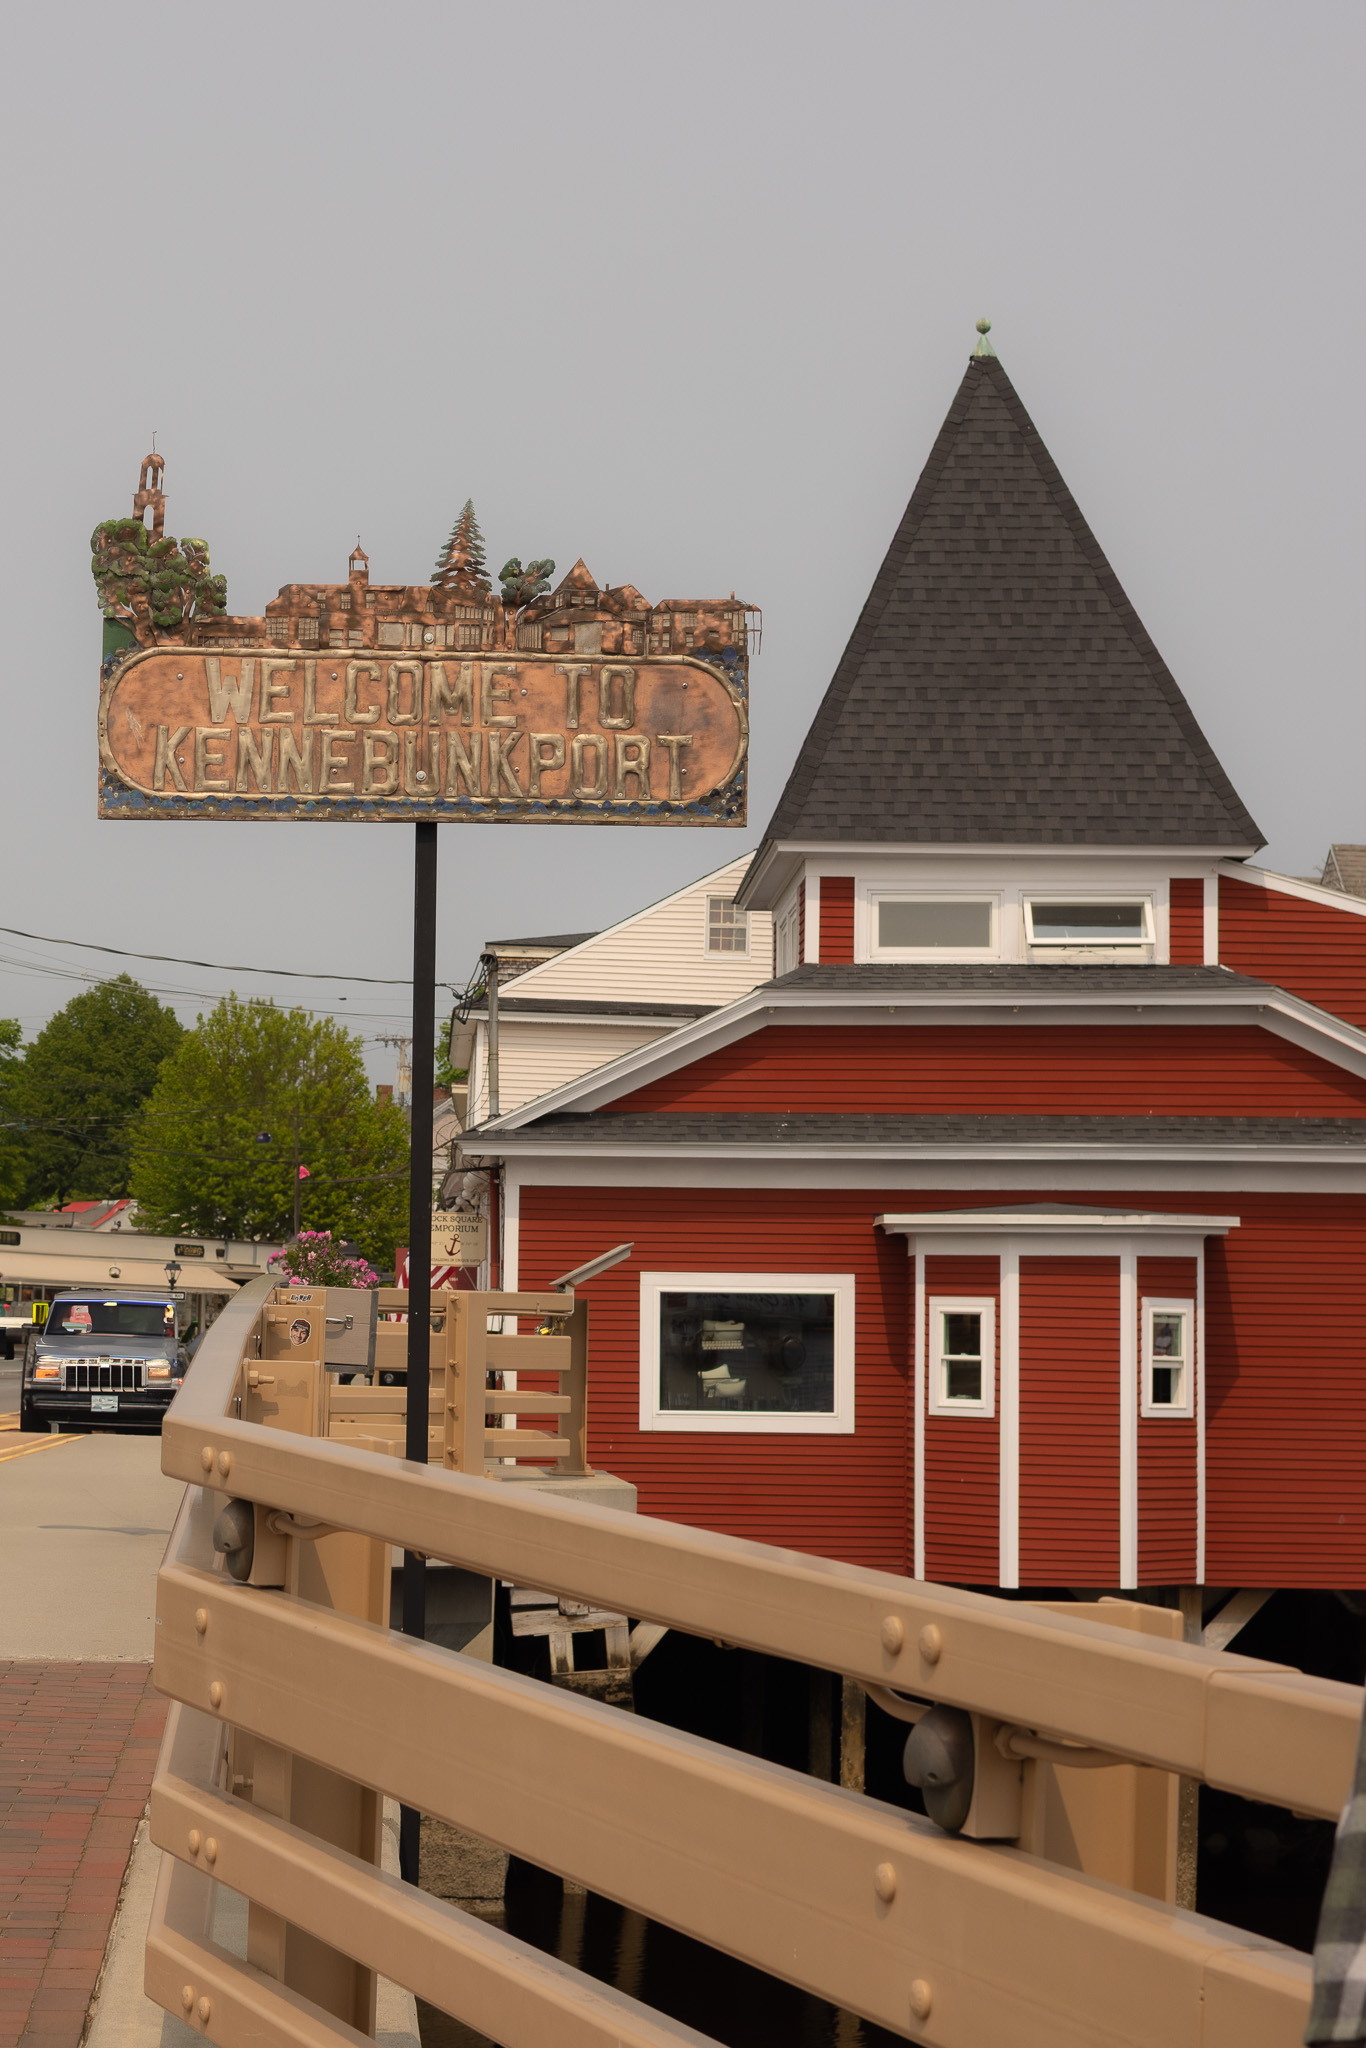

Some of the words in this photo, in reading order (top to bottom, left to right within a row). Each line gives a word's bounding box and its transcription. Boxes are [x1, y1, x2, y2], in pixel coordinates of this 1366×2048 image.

[204, 657, 518, 728] WELCOME
[554, 663, 636, 730] TO
[154, 724, 693, 801] KENNEBUNKPORT
[431, 1224, 479, 1233] EMPORIUM
[450, 1215, 483, 1223] SQUARE
